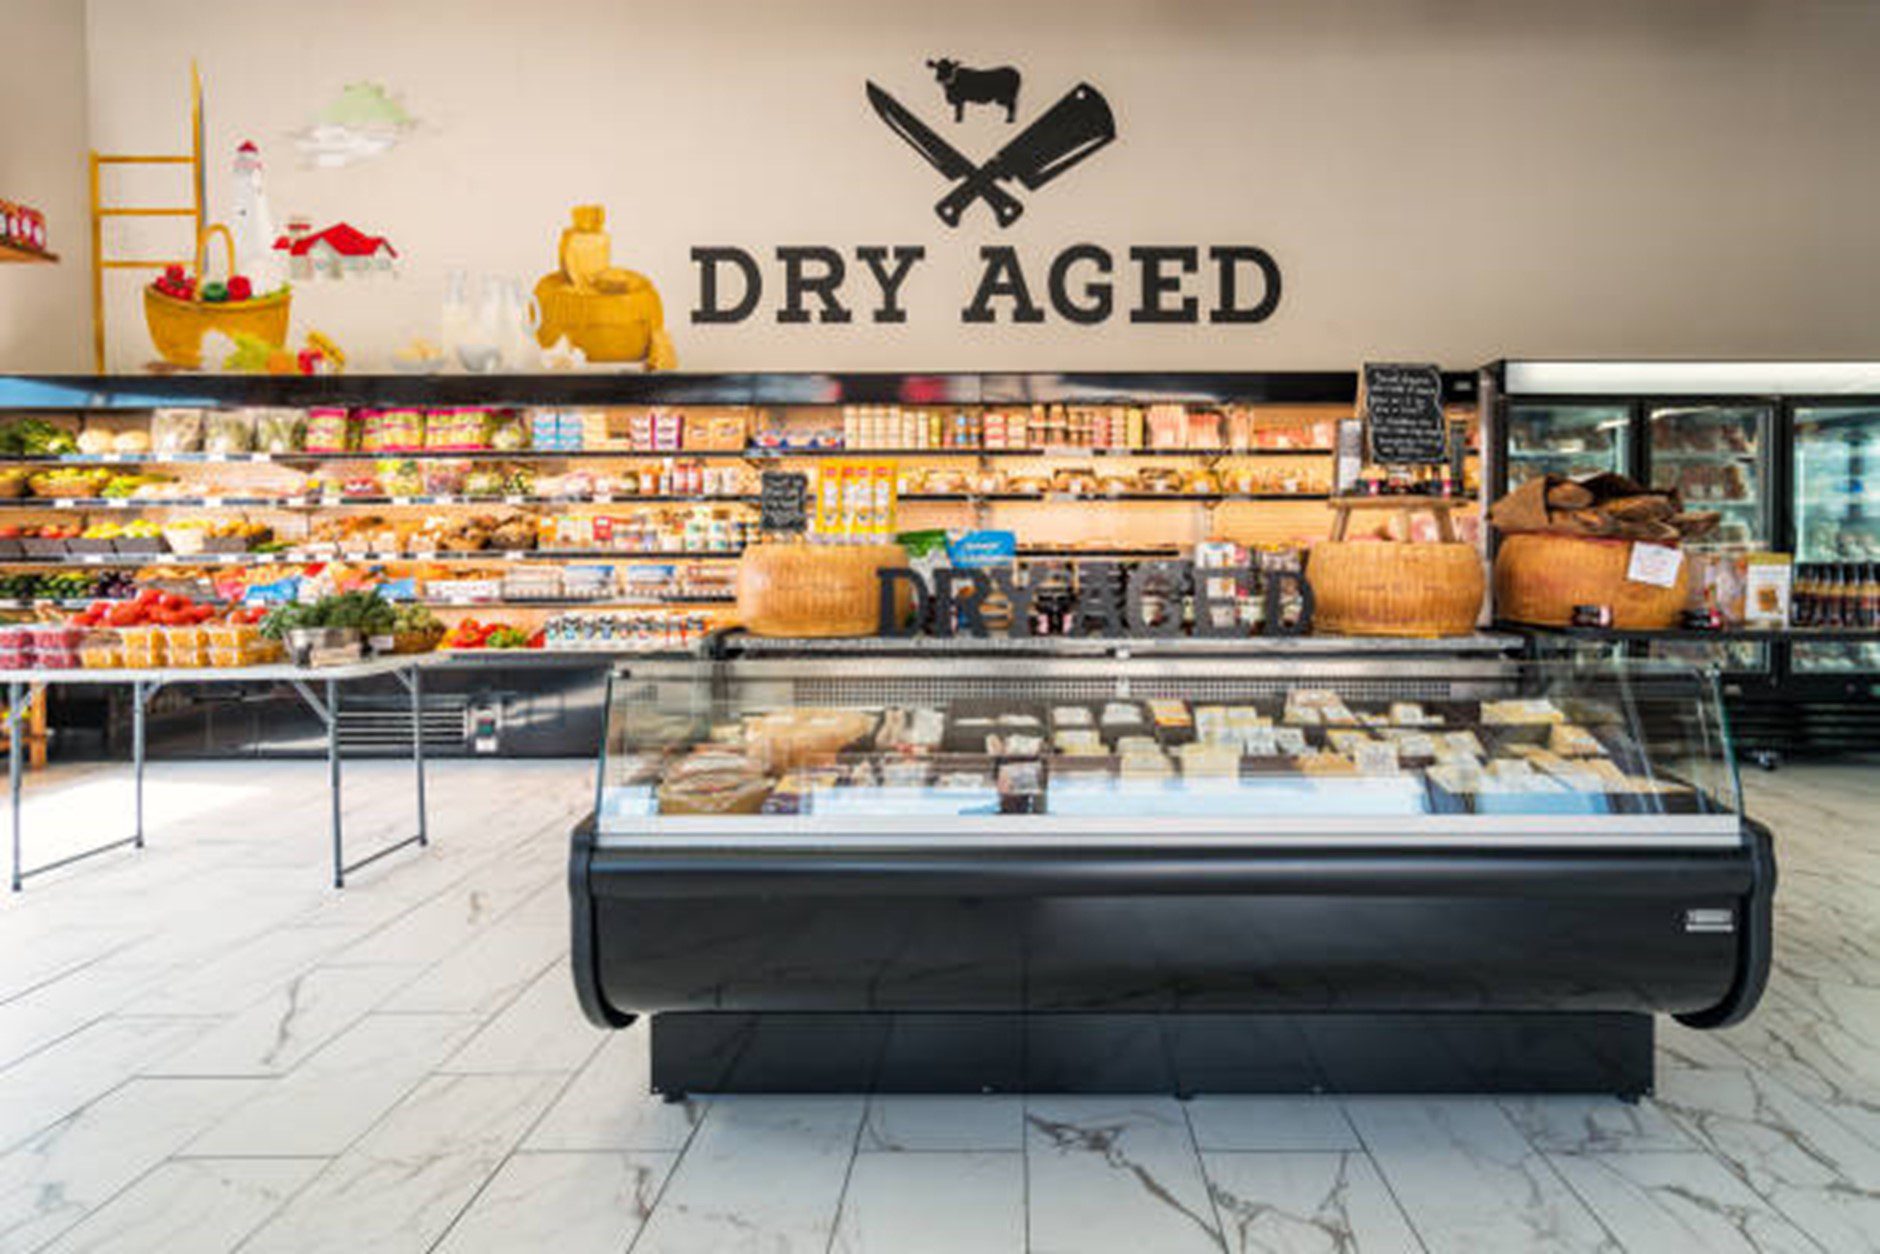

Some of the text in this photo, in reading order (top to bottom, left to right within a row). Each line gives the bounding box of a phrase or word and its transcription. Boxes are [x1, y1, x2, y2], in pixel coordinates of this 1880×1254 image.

[690, 244, 1283, 325] DRY AGED
[876, 562, 1317, 639] DRY AGED
